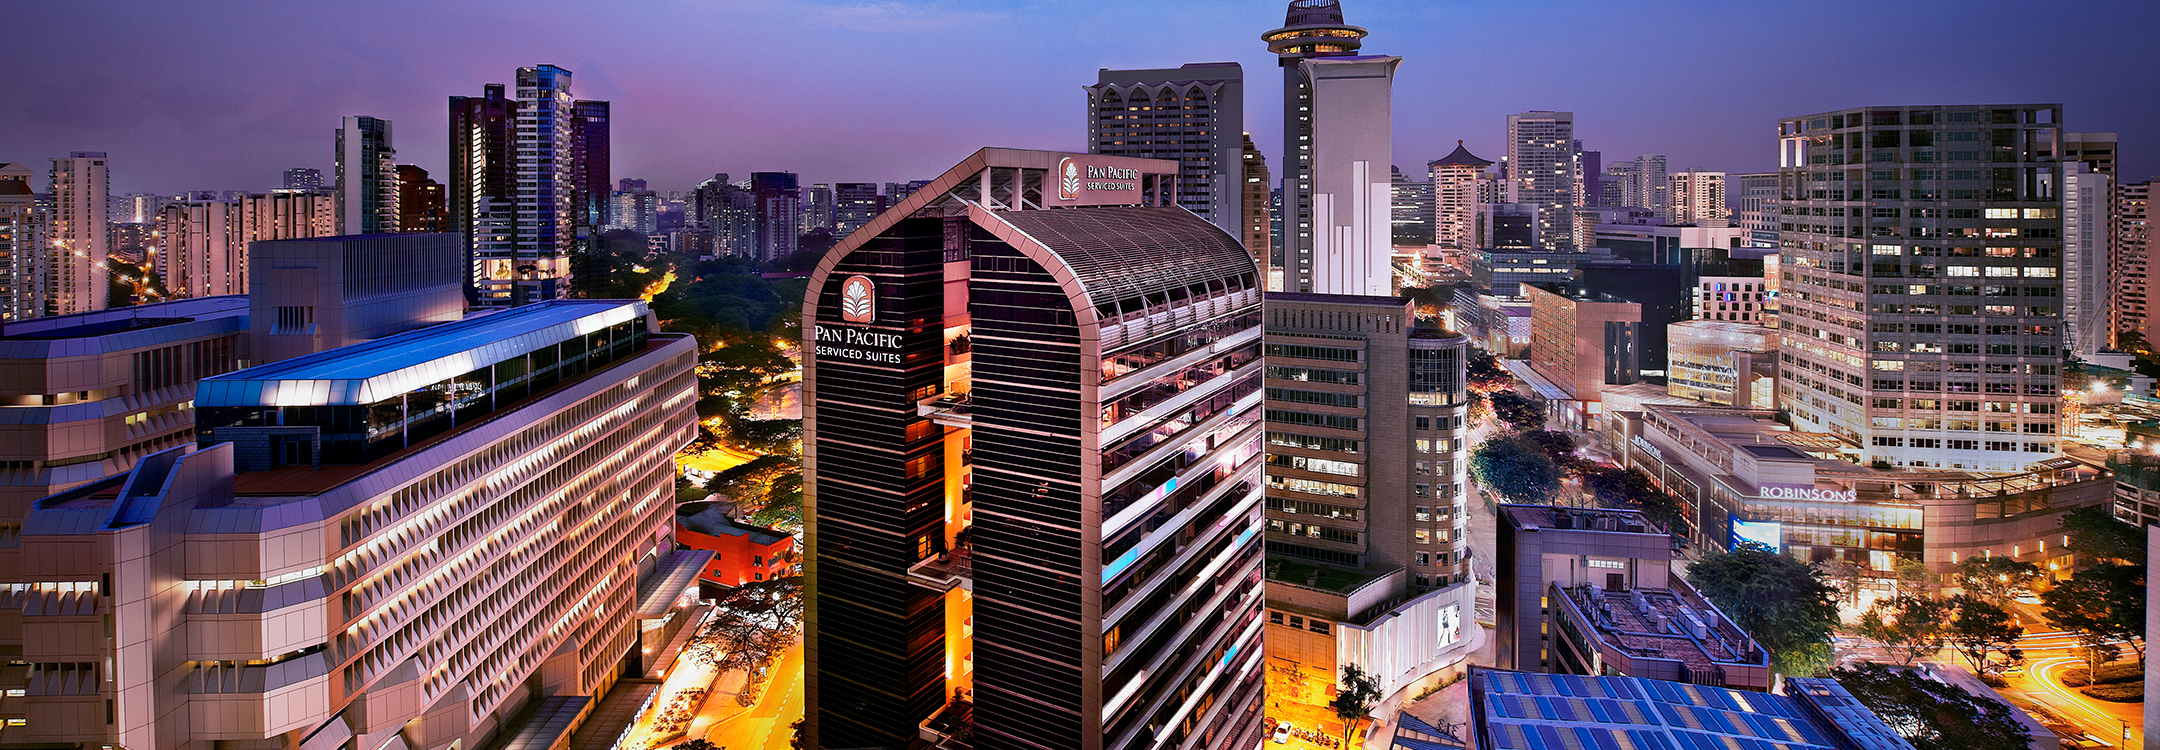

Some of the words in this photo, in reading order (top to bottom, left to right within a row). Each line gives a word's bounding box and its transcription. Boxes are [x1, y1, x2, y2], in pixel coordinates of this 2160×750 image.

[1087, 165, 1105, 179] PAN
[1107, 165, 1138, 180] PACIFIC
[1087, 182, 1115, 191] SERVICED
[1116, 182, 1135, 191] SUITES
[814, 325, 842, 342] PAN
[846, 328, 903, 349] PACIFIC
[815, 345, 863, 359] SERVICED
[866, 351, 901, 364] SUITES
[1760, 486, 1857, 502] ROBINSONS
